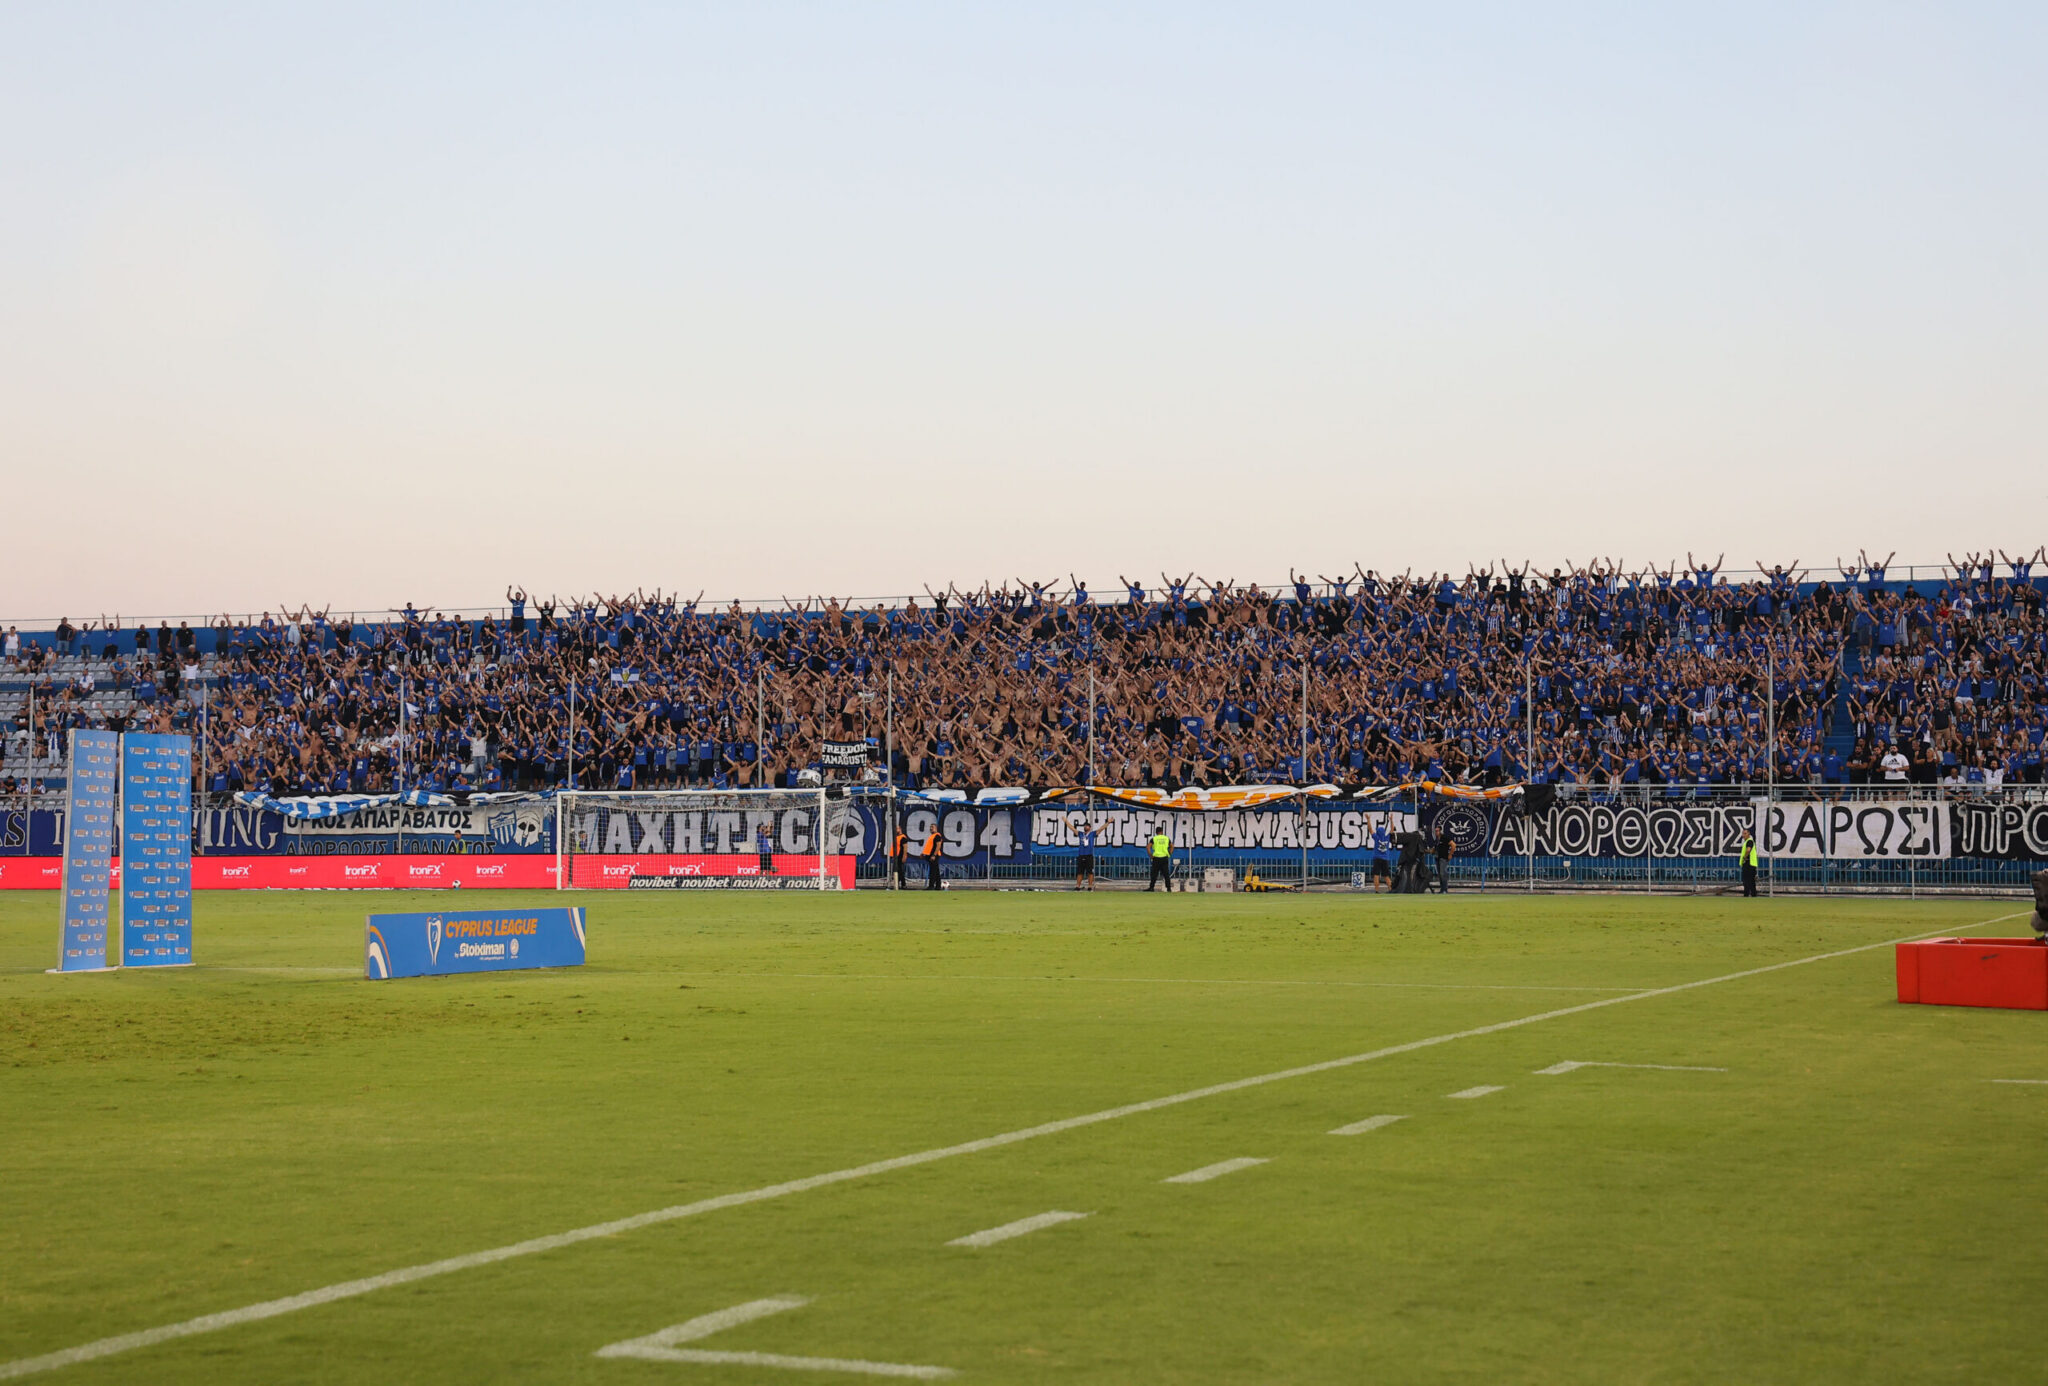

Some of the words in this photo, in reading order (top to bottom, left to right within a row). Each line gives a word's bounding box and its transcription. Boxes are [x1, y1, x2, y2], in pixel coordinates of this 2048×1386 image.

[822, 743, 867, 754] FREEDOM
[350, 810, 472, 829] ΑΠΑΡΑΒΑΤΟΣ
[1037, 810, 1129, 847] FIGHT
[1134, 811, 1196, 848] FOR
[1489, 804, 1754, 857] ΑΝΟΡΘΩΣΙΣ
[1763, 805, 1940, 855] ΒΑΡΩΣΙ
[222, 866, 250, 876] IronFX
[345, 865, 378, 876] IronFX
[409, 865, 441, 875] IronFX
[476, 865, 504, 875] IronFX
[603, 865, 636, 875] IronFX
[669, 865, 701, 875] IronFX
[737, 866, 761, 874] IronF
[629, 876, 678, 888] novibet
[681, 876, 730, 888] novibet
[733, 877, 782, 888] novibet
[445, 920, 493, 938] CYPRUS
[494, 918, 539, 936] LEAGUE
[460, 942, 505, 957] Stoiximan
